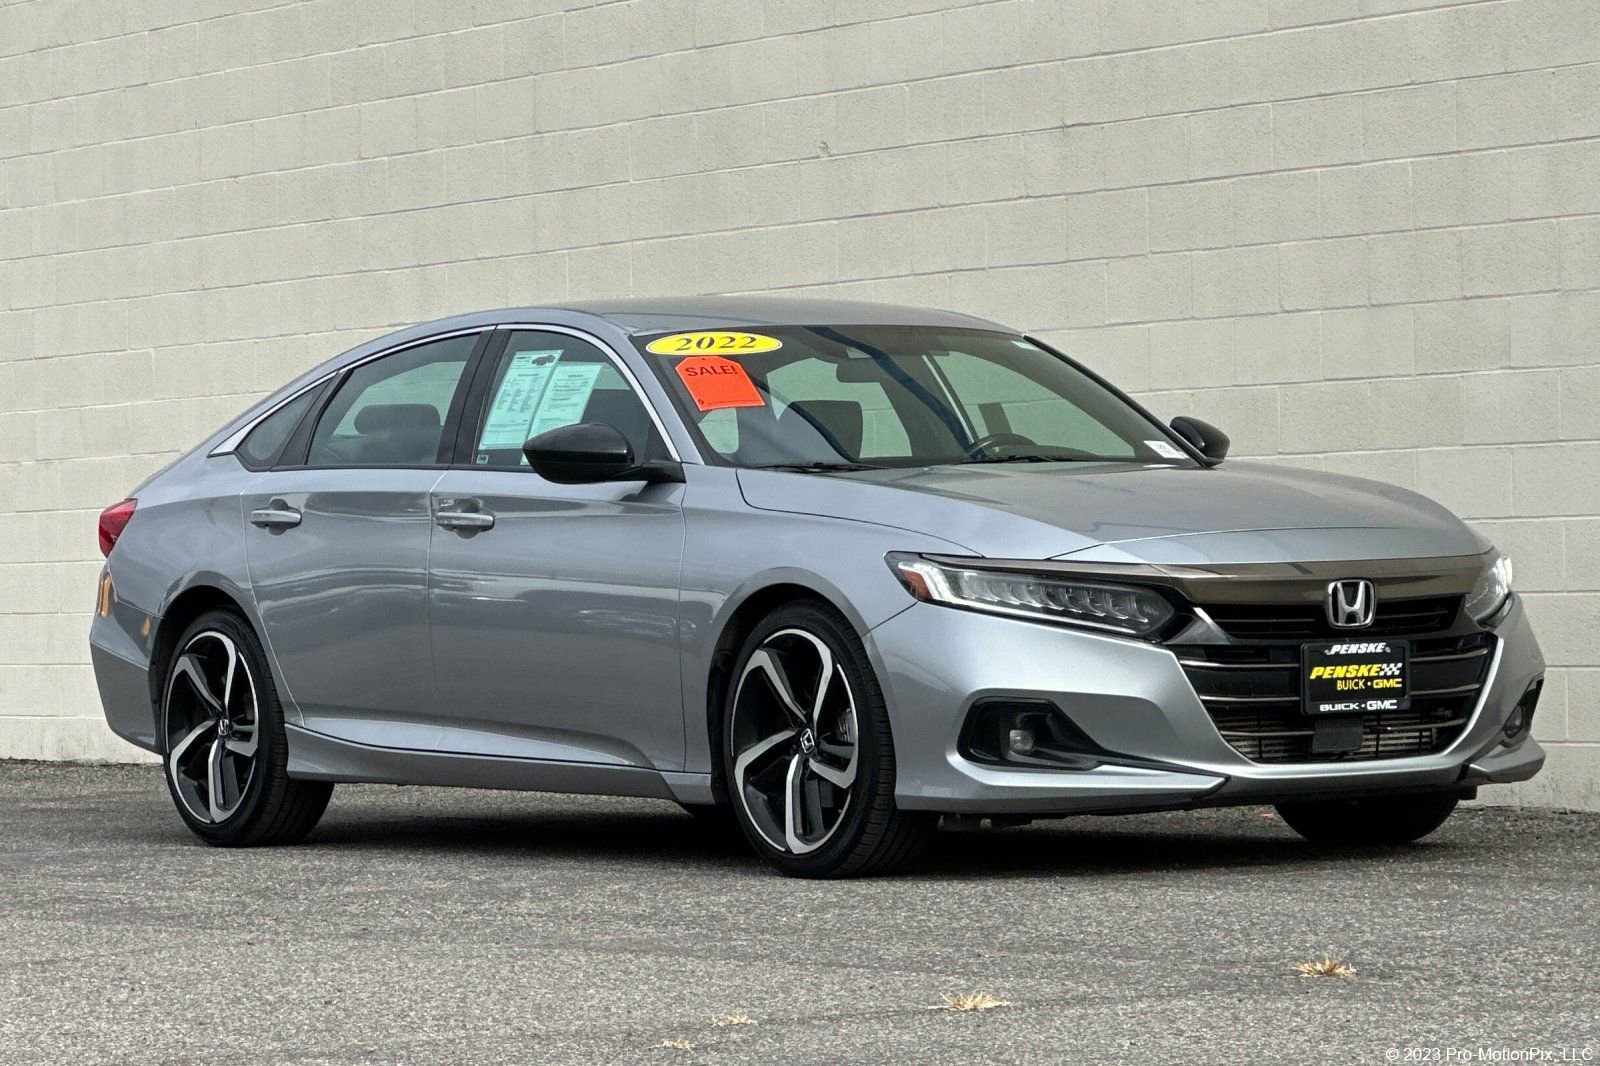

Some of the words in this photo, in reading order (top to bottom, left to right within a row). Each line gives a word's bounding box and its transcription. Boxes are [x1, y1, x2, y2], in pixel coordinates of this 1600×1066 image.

[674, 335, 757, 352] 2022
[685, 365, 739, 377] SALE!
[1329, 642, 1386, 655] PENSKE
[1310, 663, 1382, 680] PENSKE
[1336, 678, 1366, 691] BUICK
[1372, 678, 1402, 689] GMC
[1320, 702, 1359, 712] BUICK
[1366, 699, 1398, 711] GMC
